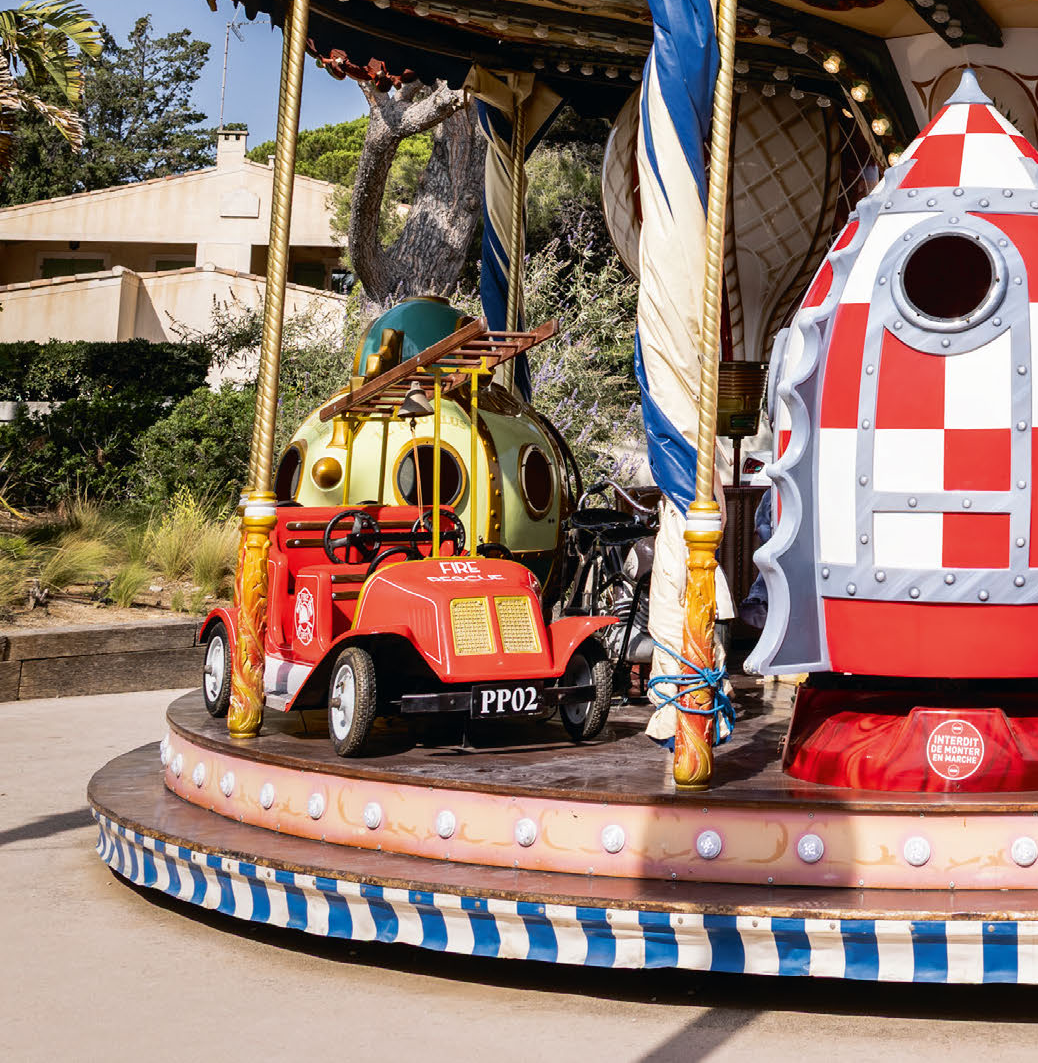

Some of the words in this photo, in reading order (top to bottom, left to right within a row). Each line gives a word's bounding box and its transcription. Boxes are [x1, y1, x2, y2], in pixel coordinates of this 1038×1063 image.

[439, 561, 480, 574] FIRE
[426, 574, 505, 582] RESCUE
[480, 686, 539, 714] PP02
[934, 735, 979, 747] INTERDIT
[931, 744, 943, 753] DE
[944, 745, 980, 756] MONTER
[932, 754, 943, 762] EN
[944, 754, 977, 764] MARCHE
